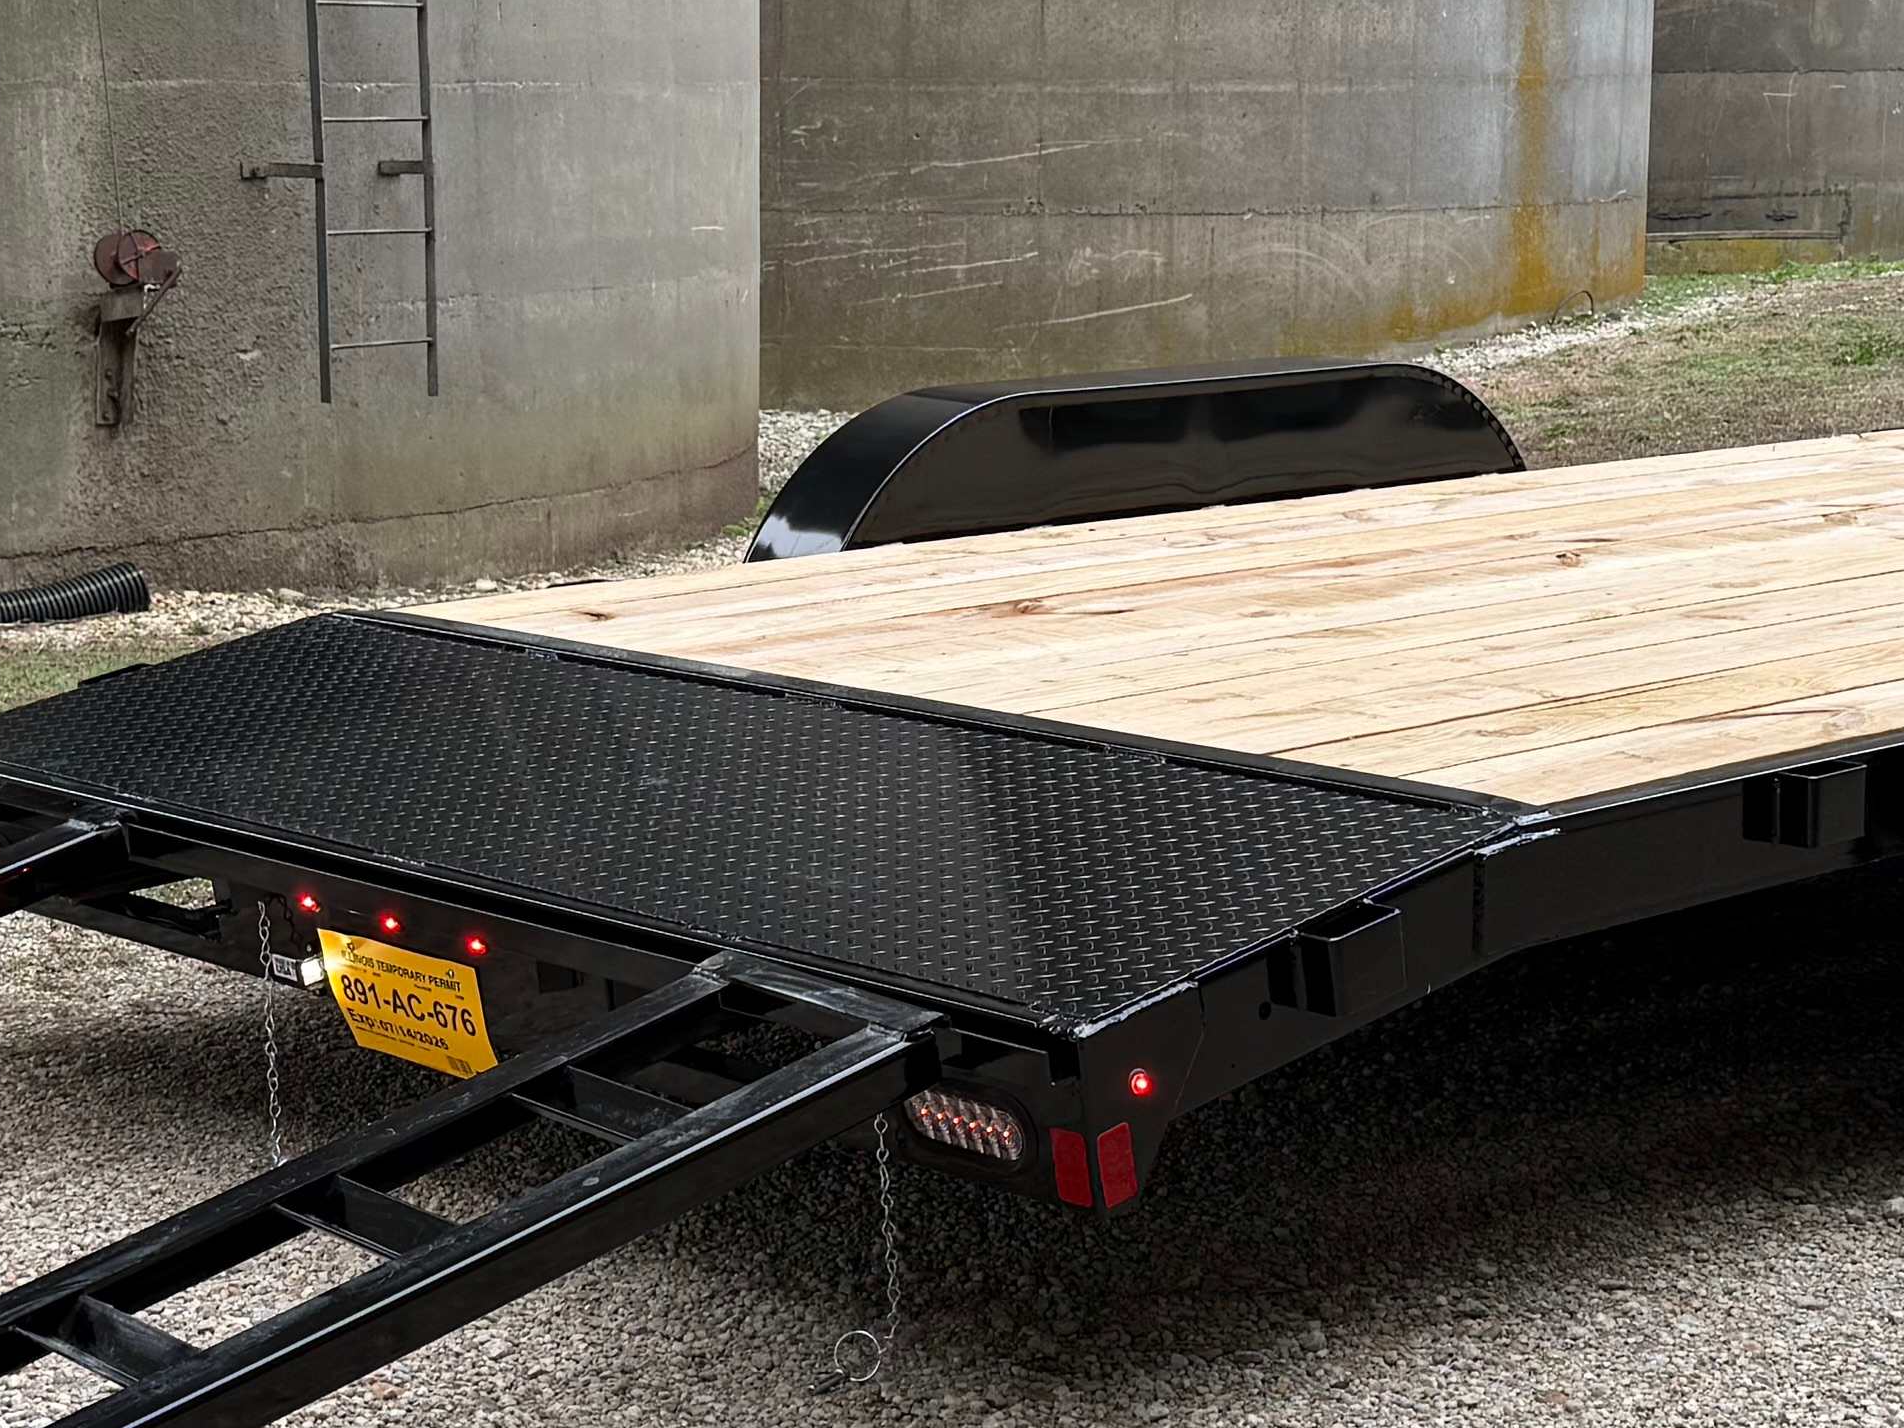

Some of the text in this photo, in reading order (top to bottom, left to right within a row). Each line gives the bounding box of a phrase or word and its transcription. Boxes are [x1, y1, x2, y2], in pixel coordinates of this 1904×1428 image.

[376, 959, 427, 983] TEMPORARY
[428, 974, 461, 993] PERMIT
[341, 974, 476, 1037] 891-AC-676
